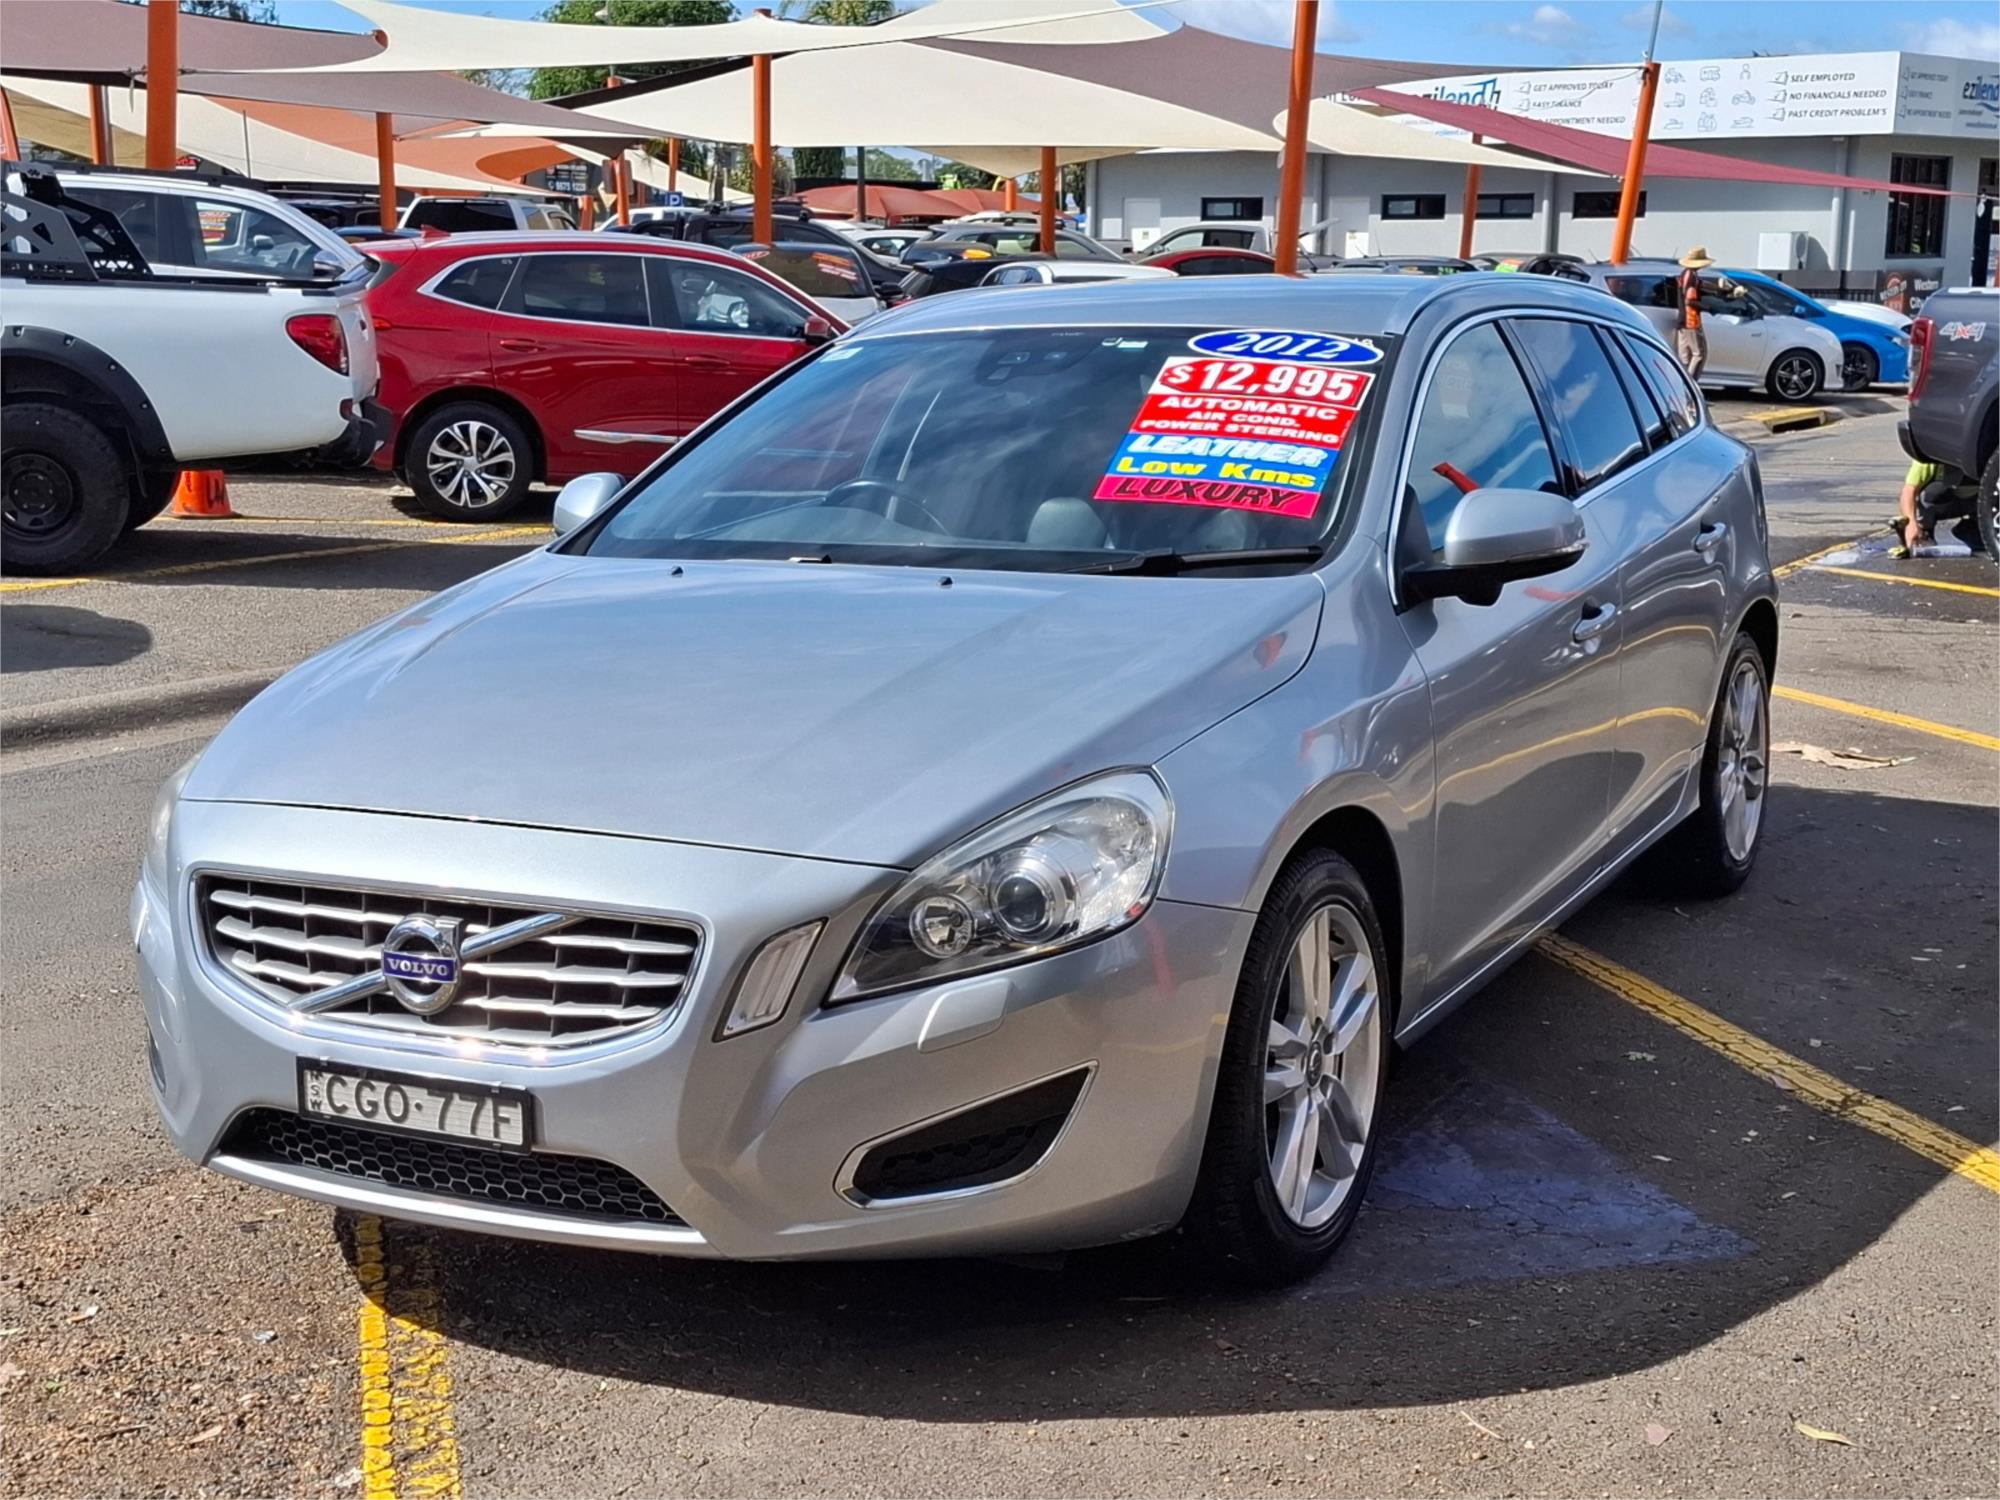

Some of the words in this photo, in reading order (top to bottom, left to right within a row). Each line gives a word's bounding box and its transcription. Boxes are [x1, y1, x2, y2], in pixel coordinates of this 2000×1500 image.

[1533, 84, 1546, 92] GET
[1549, 82, 1587, 91] APPROVED
[1589, 81, 1614, 90] TODAY
[1791, 74, 1809, 82] SELF
[1811, 73, 1855, 82] EMPLOYED
[1789, 92, 1802, 100] NO
[1803, 91, 1851, 99] FINANCIALS
[1853, 90, 1887, 98] NEEDED
[1597, 116, 1626, 124] NEEDED
[1788, 110, 1808, 118] PAST
[1809, 109, 1839, 118] CREDIT
[1840, 108, 1887, 116] PROBLEM'S
[1217, 333, 1350, 359] 2012
[1166, 361, 1360, 402] $12,995
[1159, 396, 1339, 420] AUTOMATIC
[1187, 411, 1227, 422] AIR
[1231, 413, 1301, 428] COND.
[1140, 419, 1220, 432] POWER
[1224, 423, 1339, 444] STEERING
[1127, 434, 1328, 467] LEATHER
[1116, 456, 1207, 475] Low
[1218, 462, 1317, 488] Kms
[1114, 478, 1304, 509] LUXURY
[387, 957, 450, 976] VOLVO
